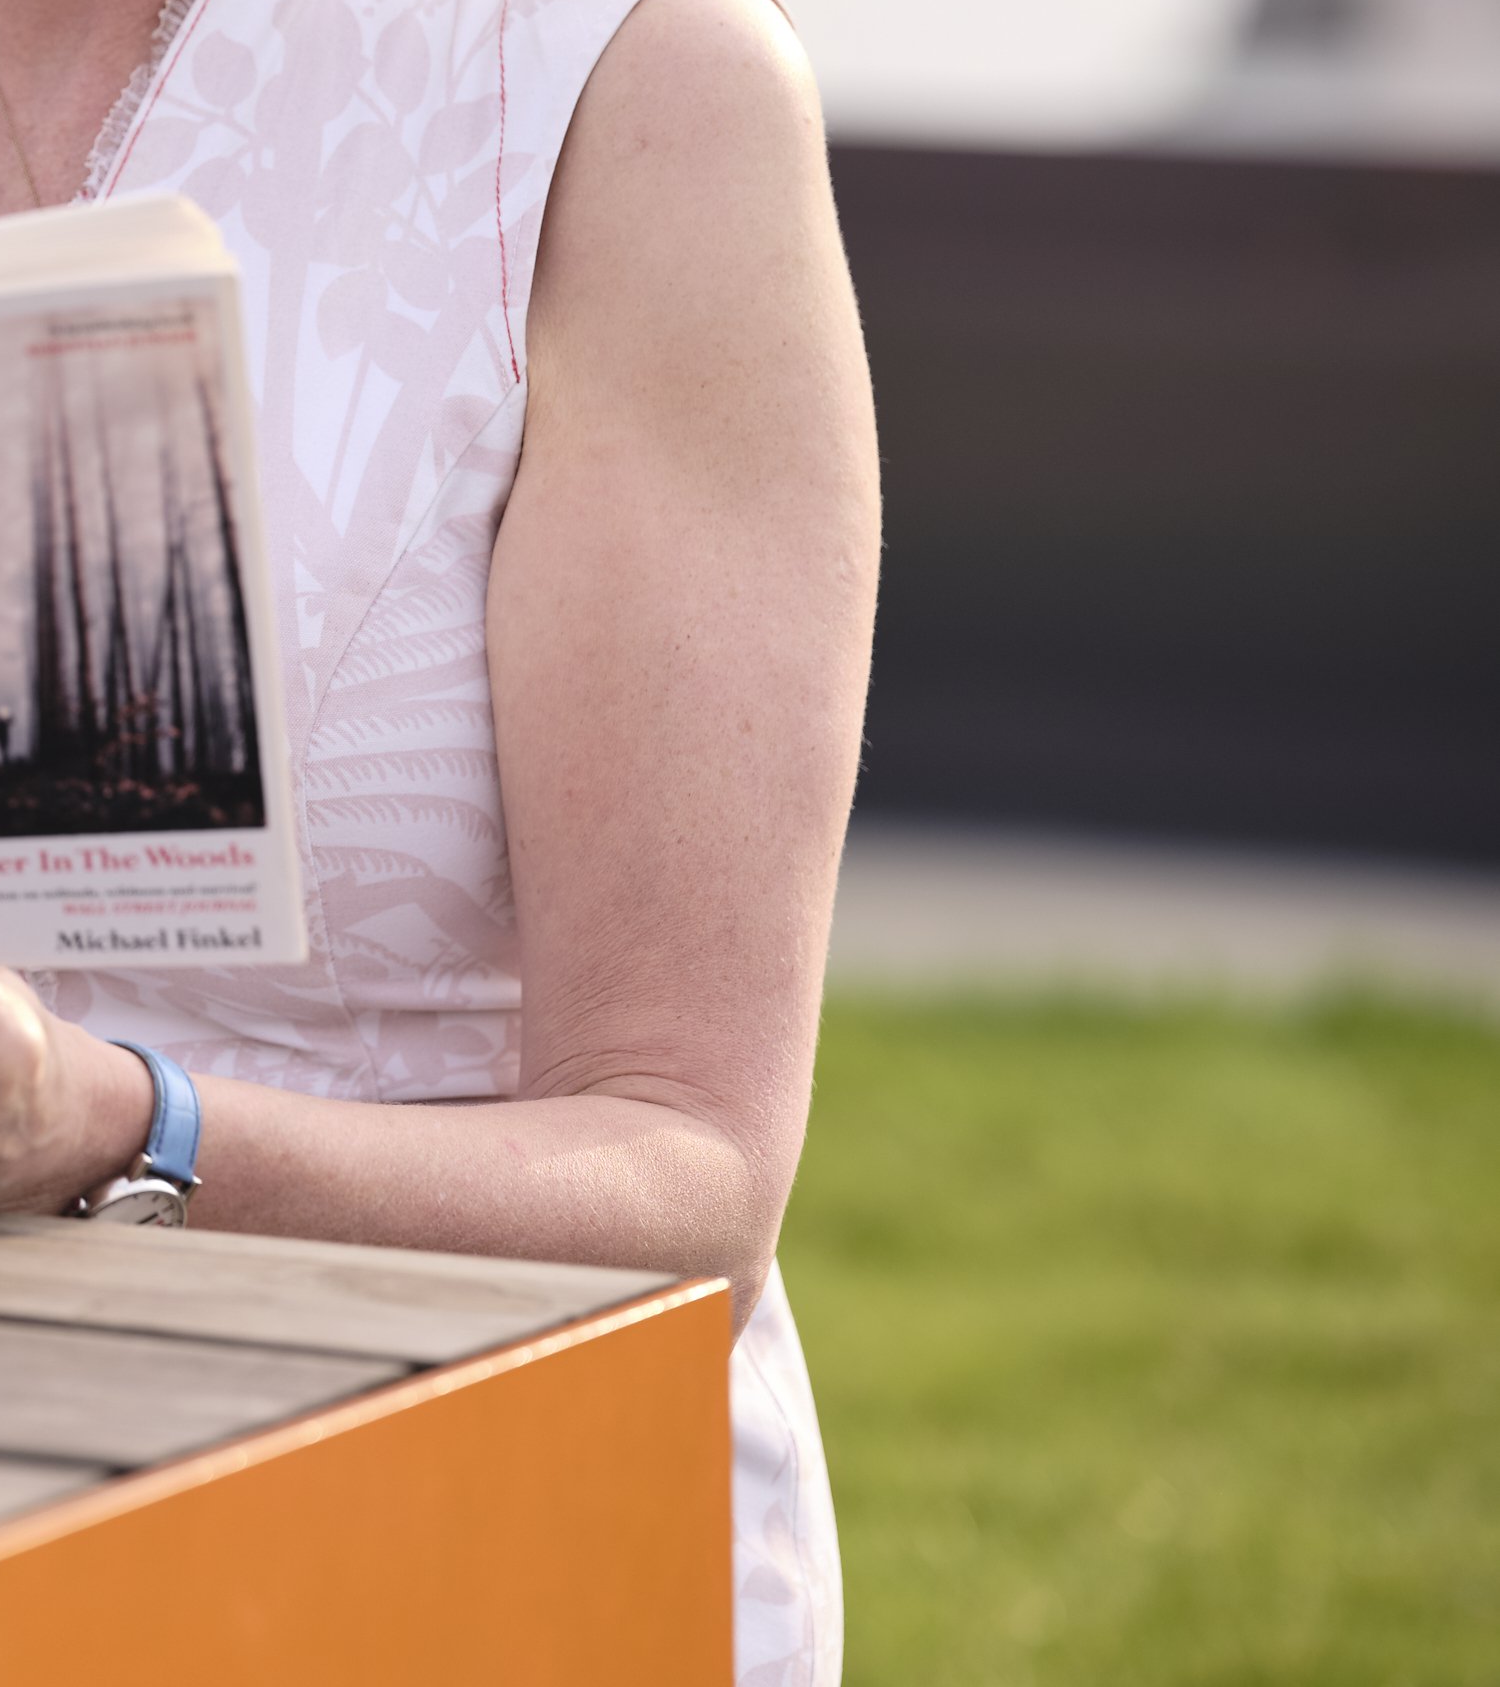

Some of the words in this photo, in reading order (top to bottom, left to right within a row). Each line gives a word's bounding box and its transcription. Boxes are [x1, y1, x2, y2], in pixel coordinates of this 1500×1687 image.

[38, 846, 74, 873] In
[75, 843, 138, 872] The
[144, 840, 256, 867] Woods
[56, 928, 169, 953] Michael
[175, 924, 263, 950] Finkel
